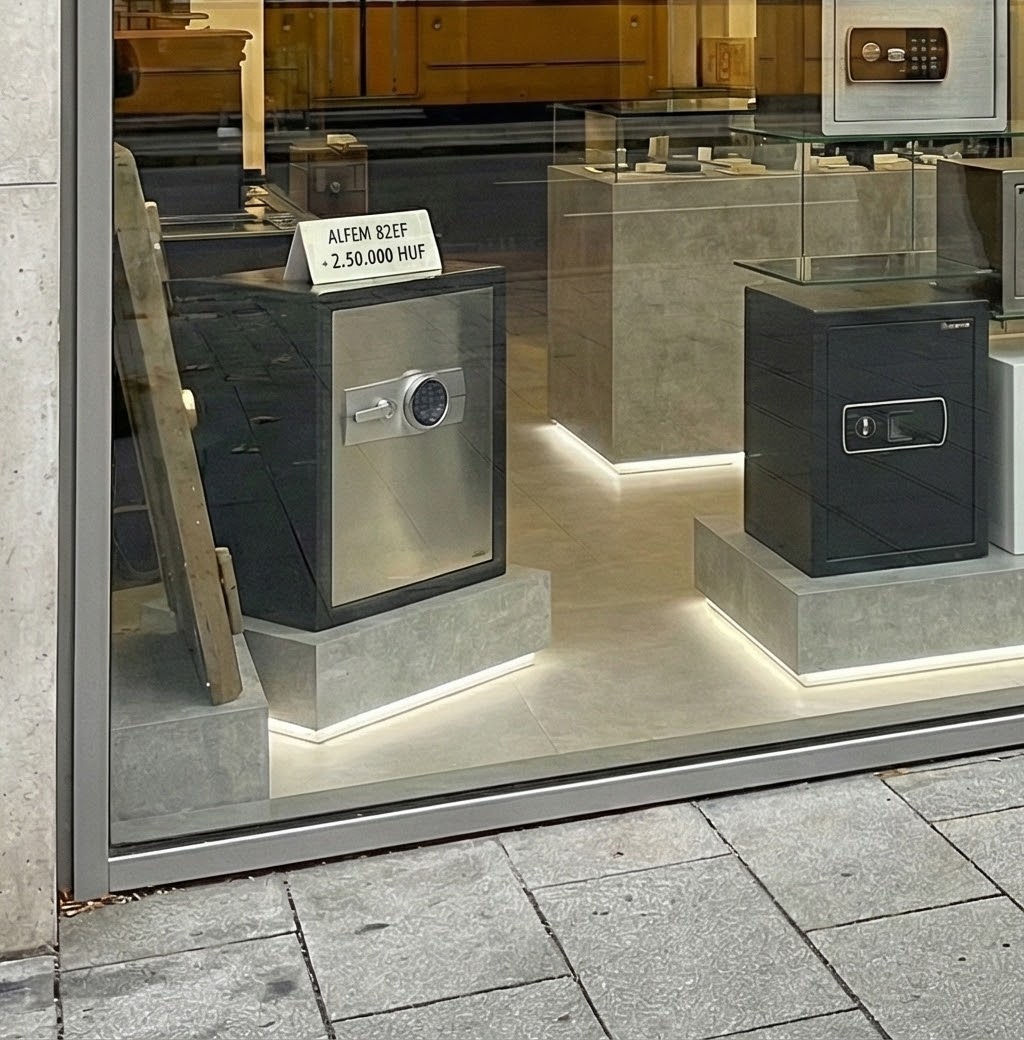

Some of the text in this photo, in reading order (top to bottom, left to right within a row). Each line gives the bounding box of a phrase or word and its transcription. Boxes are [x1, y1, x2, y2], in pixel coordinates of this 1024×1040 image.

[328, 222, 408, 245] ALFEM 82EF
[397, 243, 426, 262] HUF
